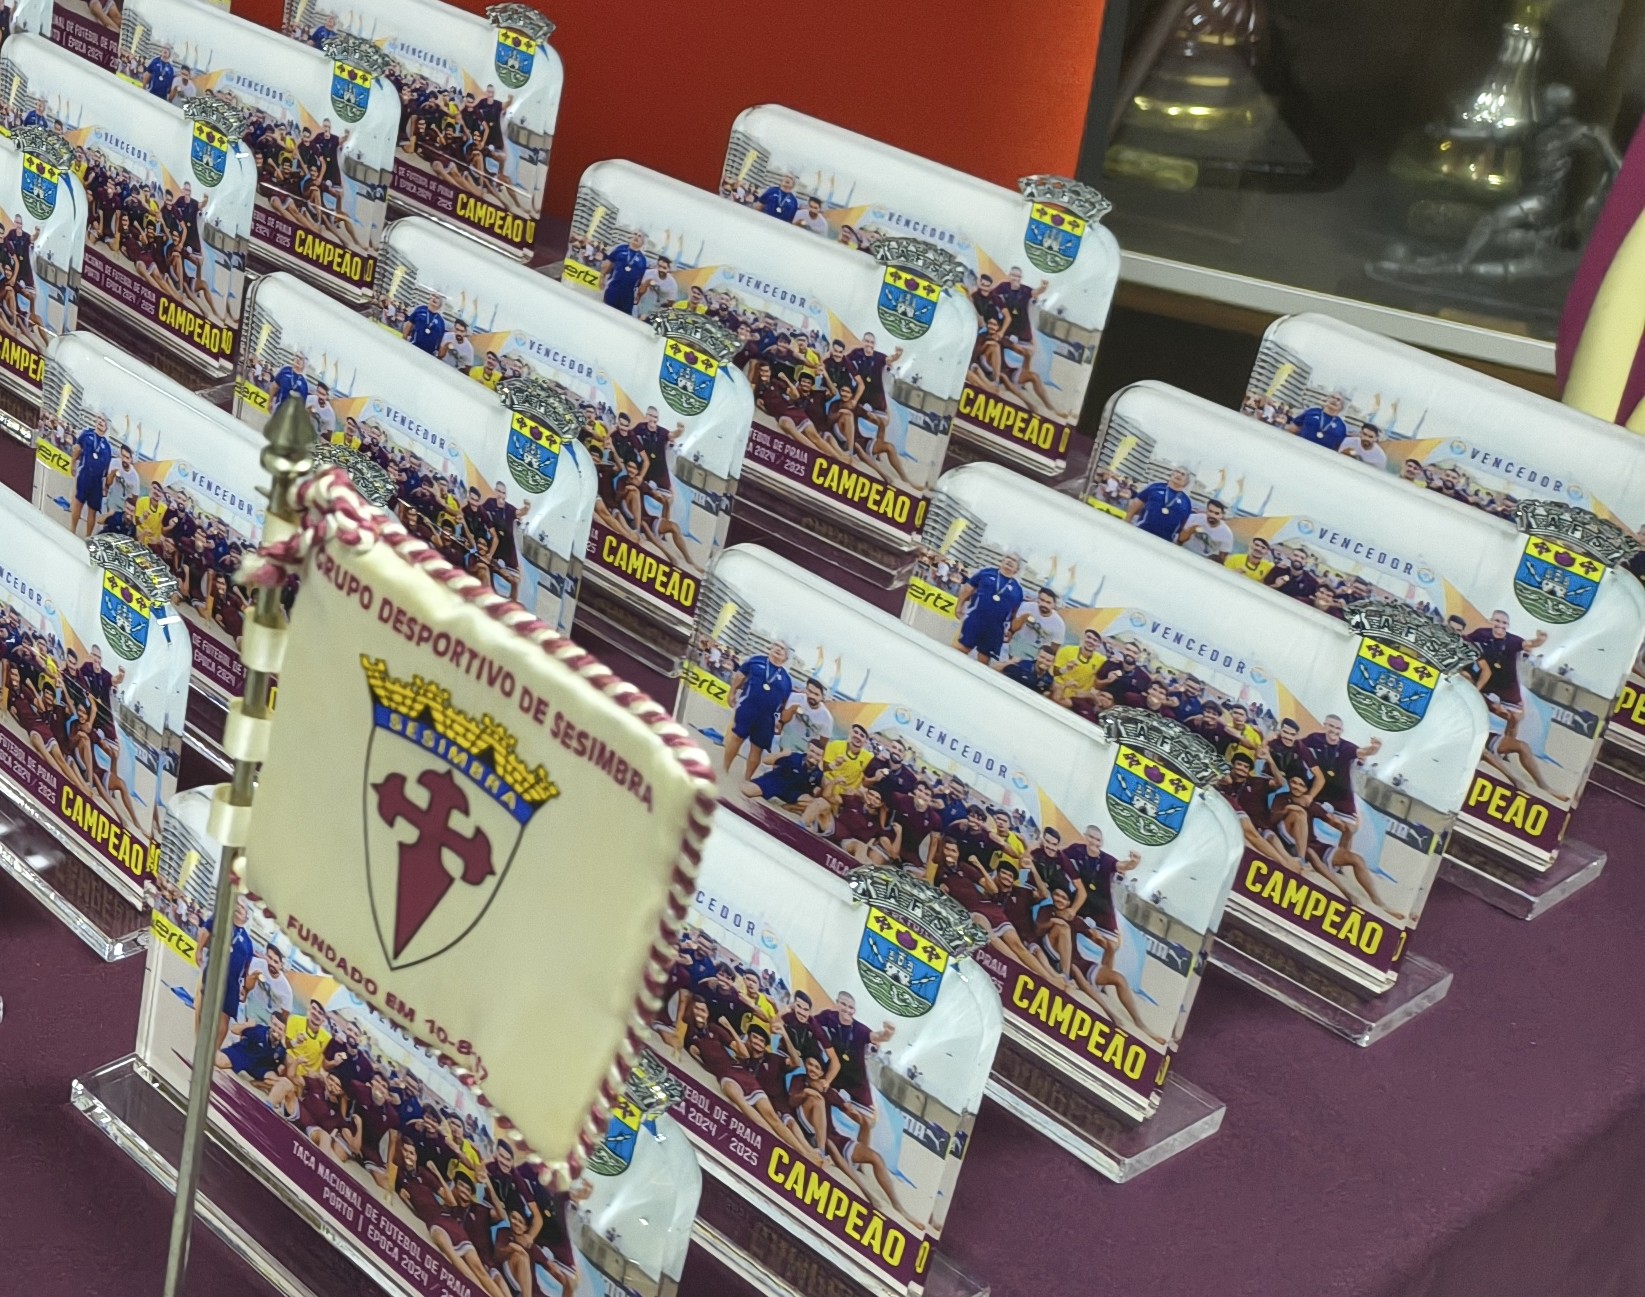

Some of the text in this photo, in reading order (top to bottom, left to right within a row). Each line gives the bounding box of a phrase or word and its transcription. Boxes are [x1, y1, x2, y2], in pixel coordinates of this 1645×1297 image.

[456, 193, 523, 243] CAMPEÃO
[294, 229, 362, 281] CAMPEÃO
[564, 264, 599, 286] ertz
[158, 297, 221, 354] CAMPEÃO
[958, 387, 1052, 450] CAMPEÃO
[38, 445, 71, 472] ertz
[1470, 448, 1563, 492] VENCEDOR
[811, 457, 911, 524] CAMPEÃO
[602, 535, 696, 607] CAMPEÃO
[1316, 526, 1414, 576] VENCEDOR
[909, 583, 955, 613] ertz
[1150, 620, 1247, 675] VENCEDOR
[377, 597, 516, 698] DESPORTIVO
[518, 685, 550, 726] DE
[549, 710, 654, 813] SESIMBRA
[681, 667, 727, 701] ertz
[388, 712, 517, 811] SESIMBRA
[914, 717, 1009, 779] VENCEDOR
[61, 785, 144, 876] CAMPEÃO
[1467, 776, 1550, 837] PEÃO
[695, 888, 756, 937] CEDOR
[1244, 859, 1384, 956] CAMPEÃO
[153, 918, 195, 959] ertz
[286, 914, 378, 996] FUNDADO
[384, 991, 417, 1023] EM
[1012, 974, 1147, 1081] CAMPEÃO
[729, 1137, 760, 1167] 2025
[767, 1146, 906, 1268] CAMPEÃO
